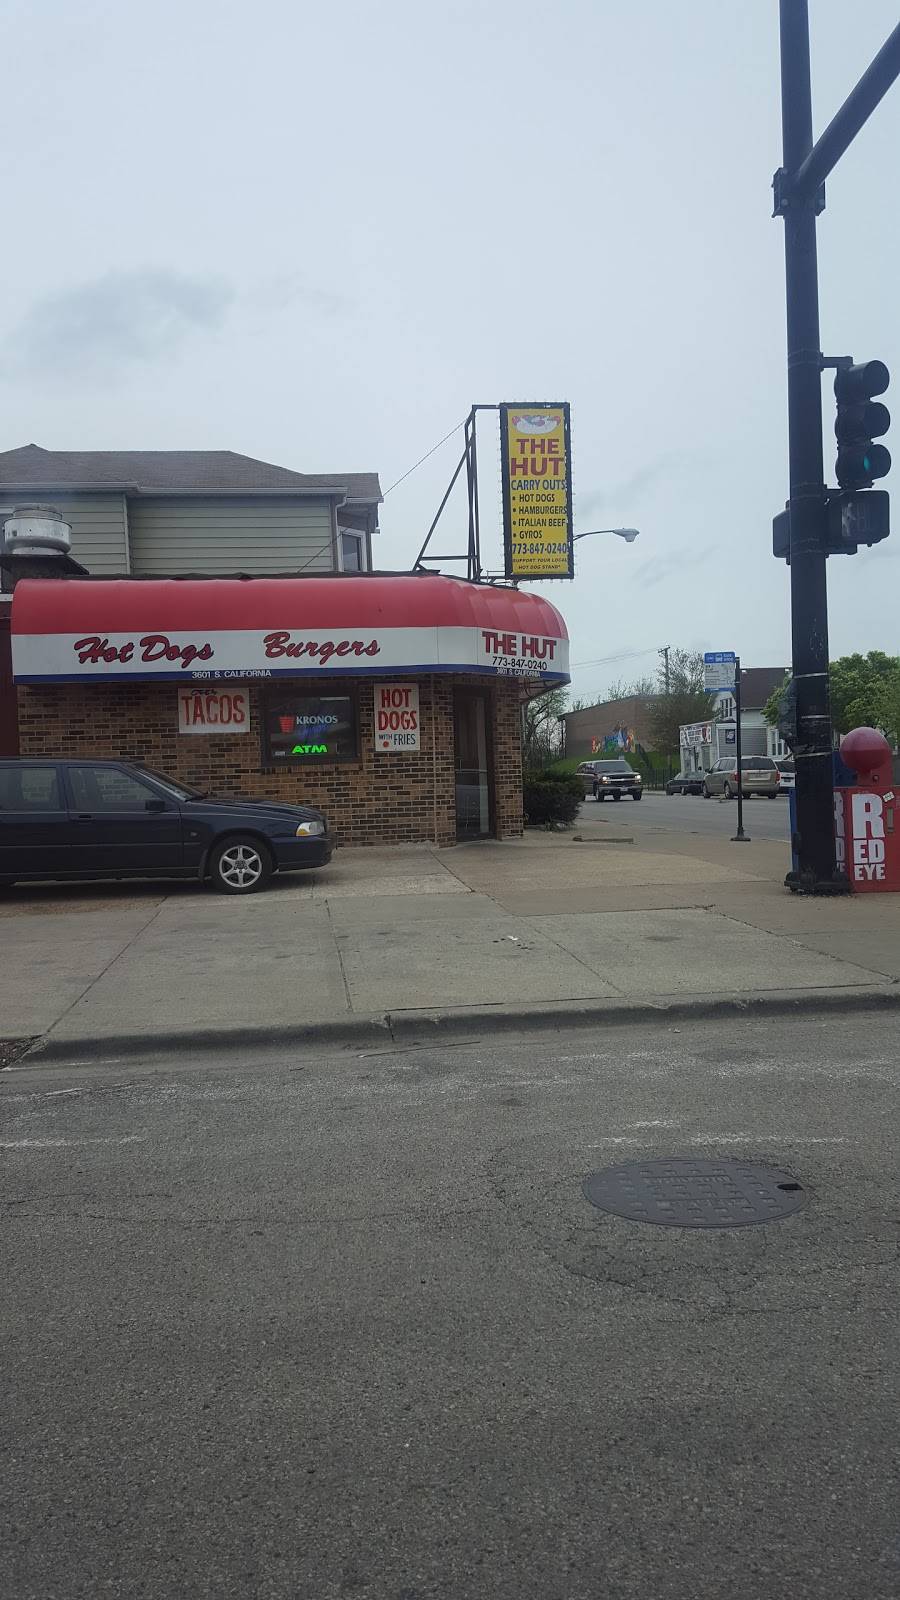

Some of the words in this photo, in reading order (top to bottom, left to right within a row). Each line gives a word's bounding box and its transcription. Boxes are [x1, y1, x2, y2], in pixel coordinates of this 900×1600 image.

[516, 438, 559, 454] THE
[511, 457, 563, 476] HUT
[511, 480, 540, 490] CARRY
[542, 480, 566, 491] OUTS
[519, 494, 535, 502] HOT
[536, 494, 555, 502] DOGS
[518, 506, 567, 515] HAMBURGERS
[518, 519, 547, 527] ITALIAN
[548, 518, 566, 527] BEEF
[519, 528, 543, 539] GYROS
[74, 636, 135, 664] Hot
[139, 635, 214, 668] Dogs
[263, 631, 381, 665] Burgers
[482, 631, 517, 656] THE
[522, 636, 557, 660] HUT
[492, 656, 548, 671] 773-847-0240
[192, 671, 211, 679] 3601
[224, 669, 272, 678] CALIFORNIA
[381, 688, 411, 708] HOT
[181, 694, 245, 725] TACOS
[296, 715, 338, 725] KRONOS
[378, 710, 417, 731] DOGS
[393, 734, 416, 745] FRIES
[291, 744, 328, 754] ATM
[852, 793, 885, 838] R
[853, 839, 885, 864] ED
[854, 864, 886, 880] EYE
